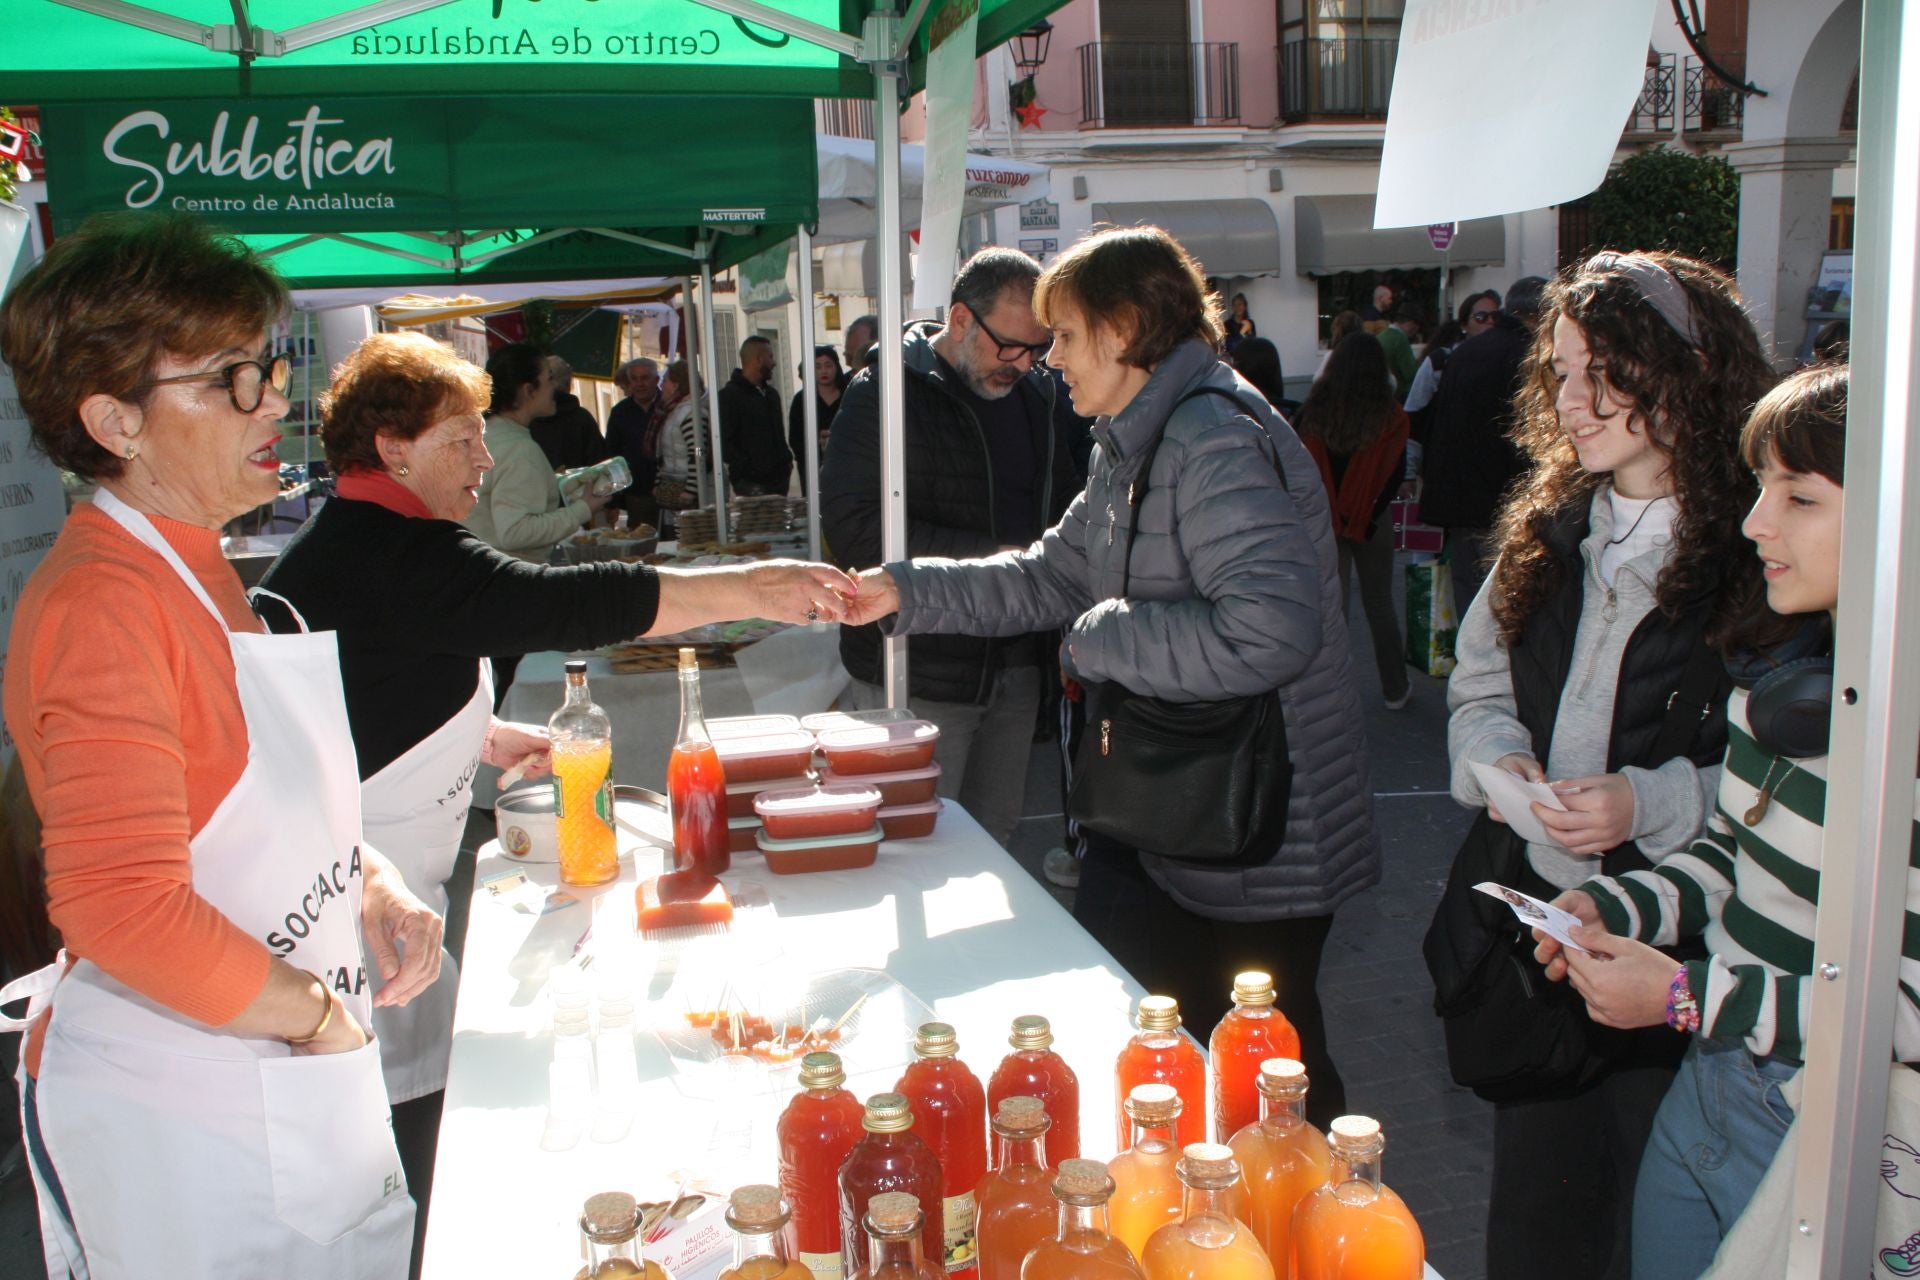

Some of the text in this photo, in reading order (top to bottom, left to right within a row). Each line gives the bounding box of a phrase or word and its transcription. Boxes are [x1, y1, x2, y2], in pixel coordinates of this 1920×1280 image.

[103, 105, 396, 209] Subbética
[966, 168, 1030, 188] ruzcampo
[172, 192, 396, 211] Centro de Andalucía
[703, 212, 765, 221] MASTERTENT
[267, 861, 346, 958] SOCIAC
[685, 1225, 714, 1246] PALILLOS
